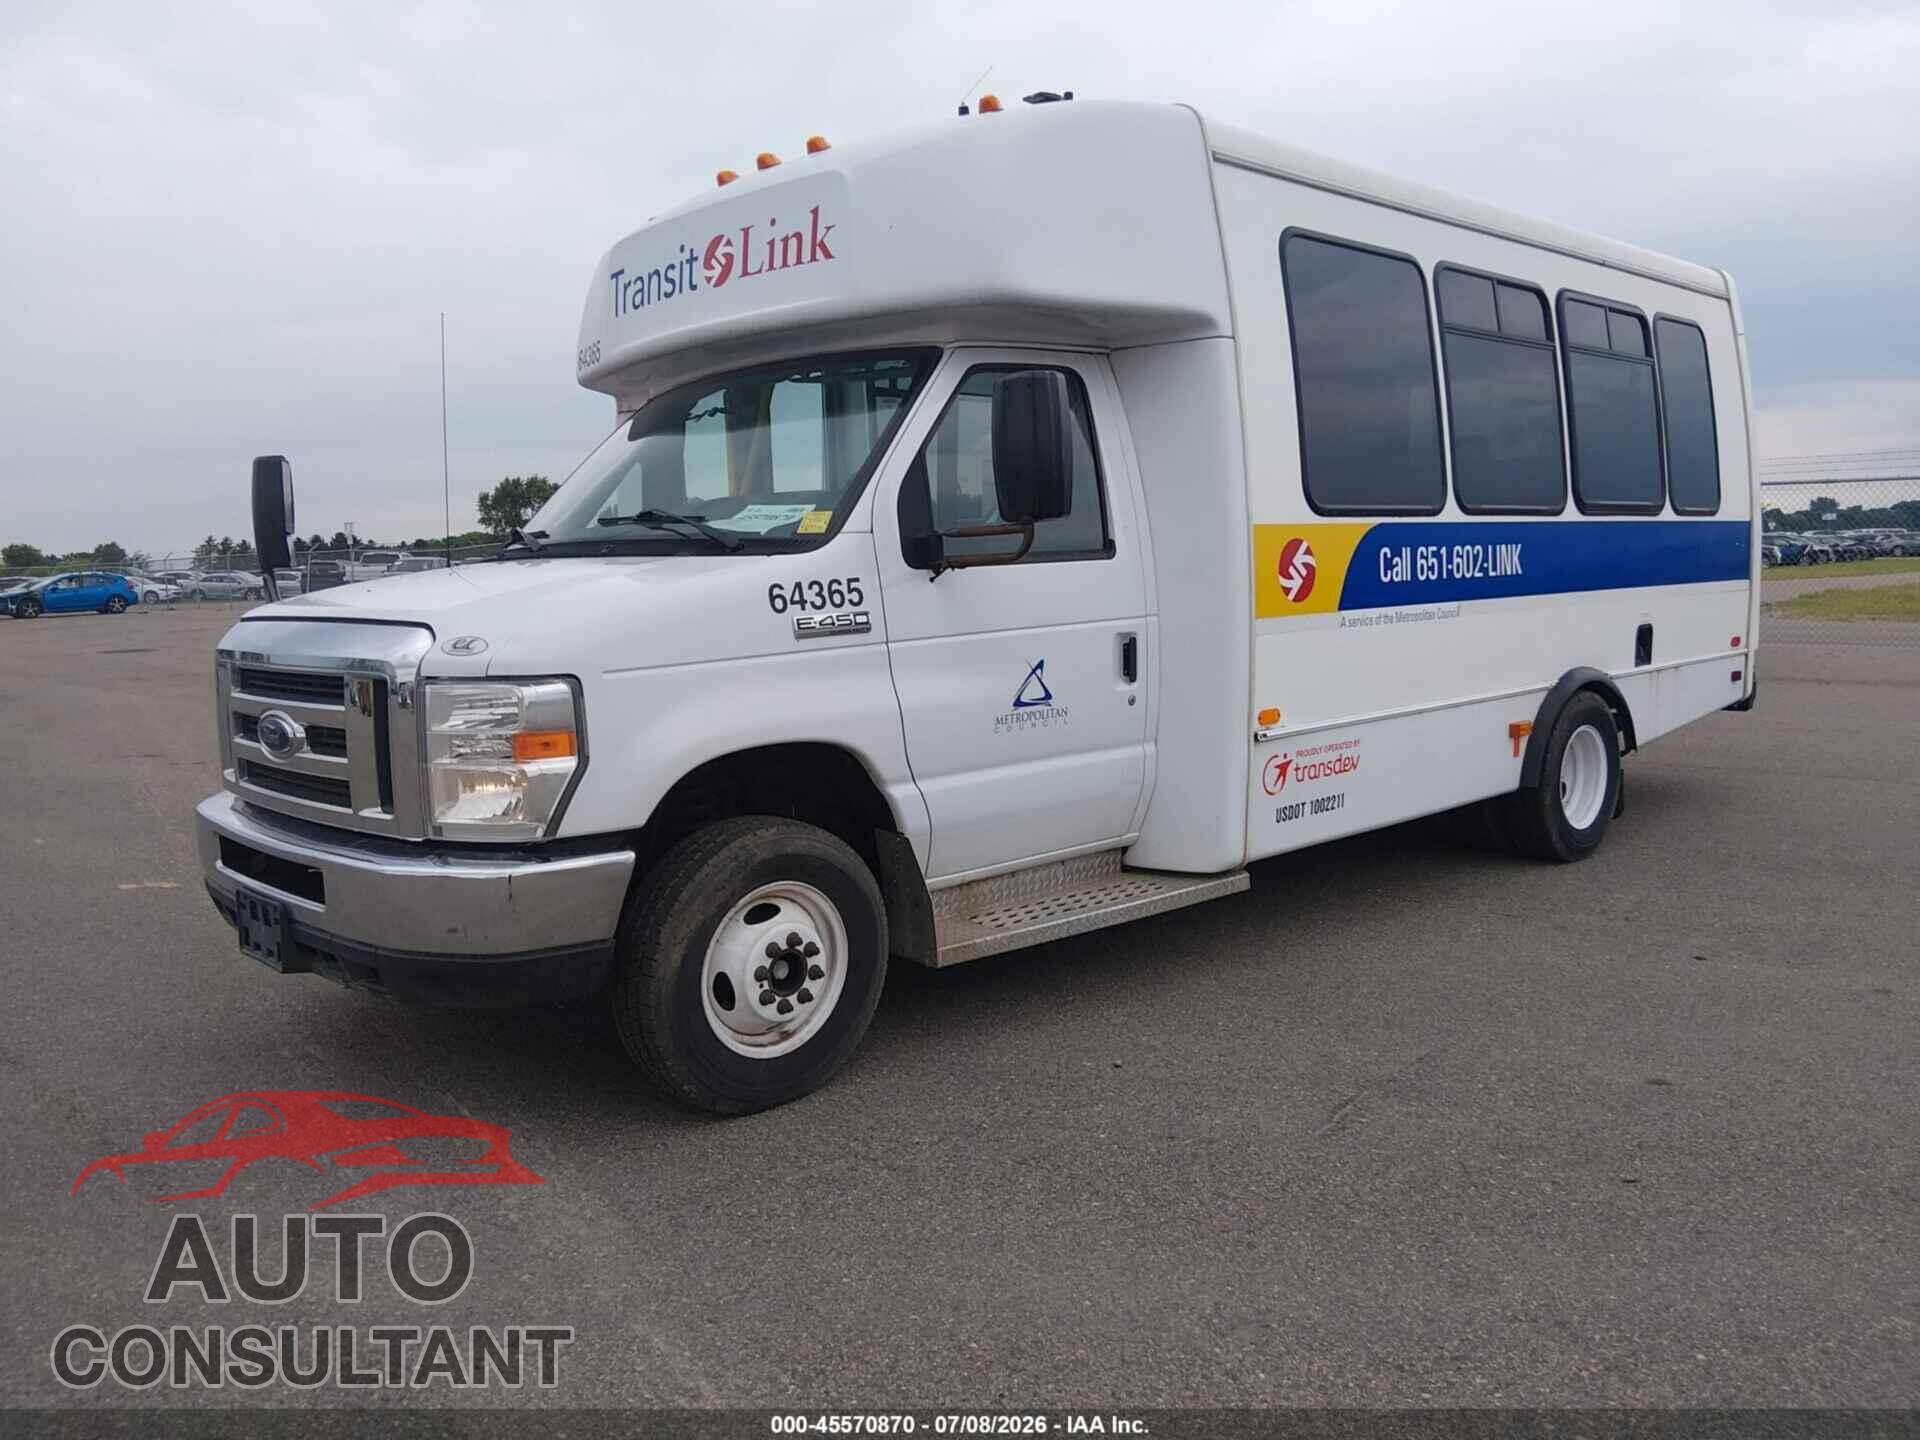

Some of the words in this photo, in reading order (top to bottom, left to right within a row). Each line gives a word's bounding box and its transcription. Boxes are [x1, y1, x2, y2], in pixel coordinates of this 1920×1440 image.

[610, 243, 698, 318] Transit
[738, 205, 836, 279] Link
[1379, 546, 1412, 583] Call
[1416, 543, 1523, 581] 651-602-LINK
[768, 577, 864, 614] 64365
[995, 706, 1069, 725] METROPOLITAN
[1294, 753, 1360, 782] transdev
[1275, 802, 1306, 823] USDOT
[1309, 793, 1345, 815] 1002211
